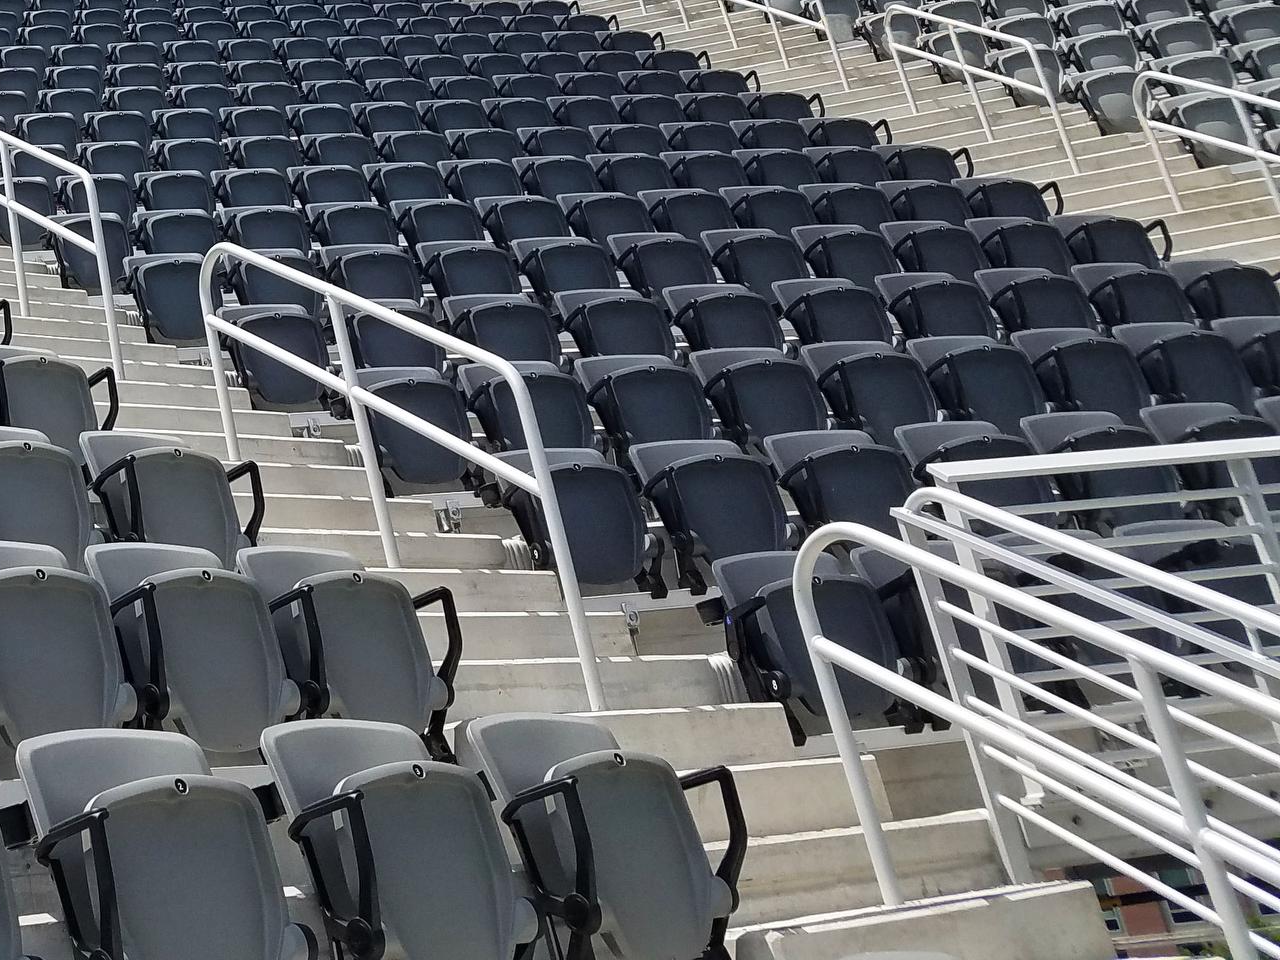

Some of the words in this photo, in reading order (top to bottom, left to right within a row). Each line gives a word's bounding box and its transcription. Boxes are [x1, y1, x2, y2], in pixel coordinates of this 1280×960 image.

[533, 549, 538, 559] 9
[772, 679, 778, 691] 8
[177, 783, 184, 791] 2
